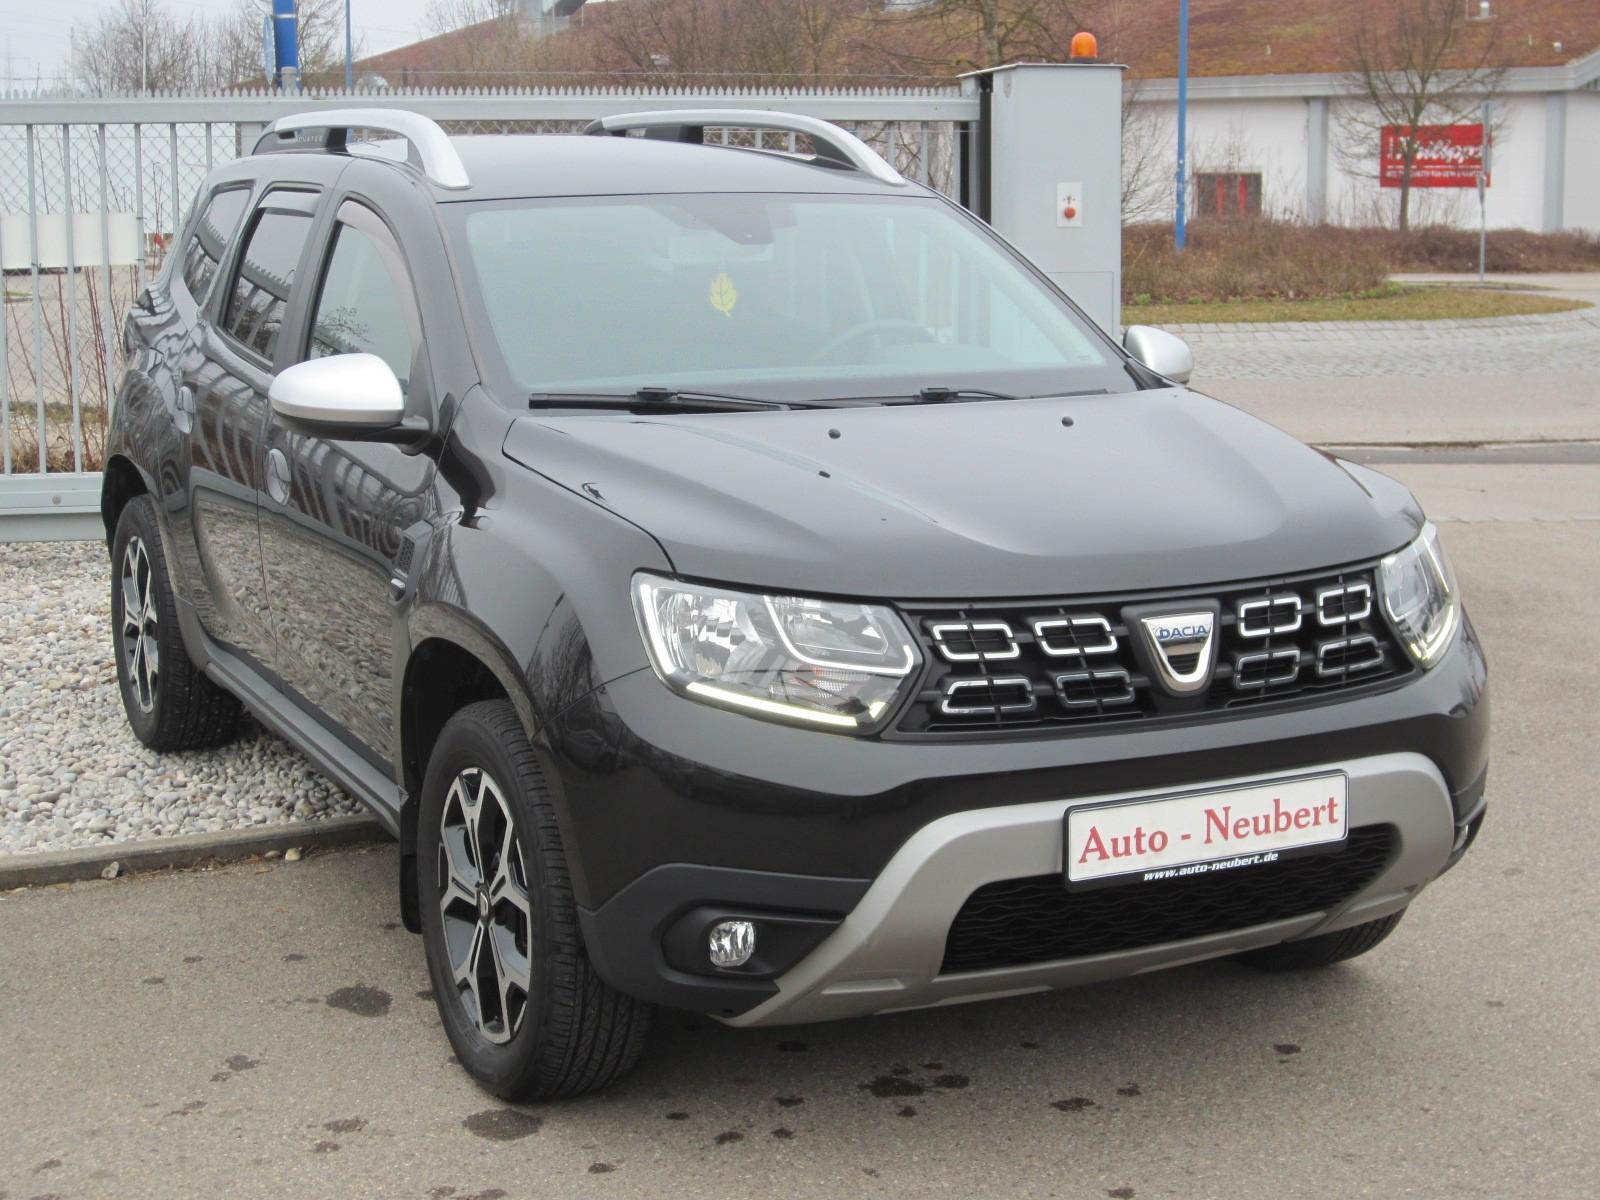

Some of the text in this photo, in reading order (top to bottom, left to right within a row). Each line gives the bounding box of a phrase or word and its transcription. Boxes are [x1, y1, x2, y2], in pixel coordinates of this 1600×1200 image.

[1159, 625, 1208, 640] DACIA
[1078, 826, 1168, 863] Auto
[1203, 797, 1339, 844] Neubert
[1143, 852, 1278, 881] www.auto-neubert.de
